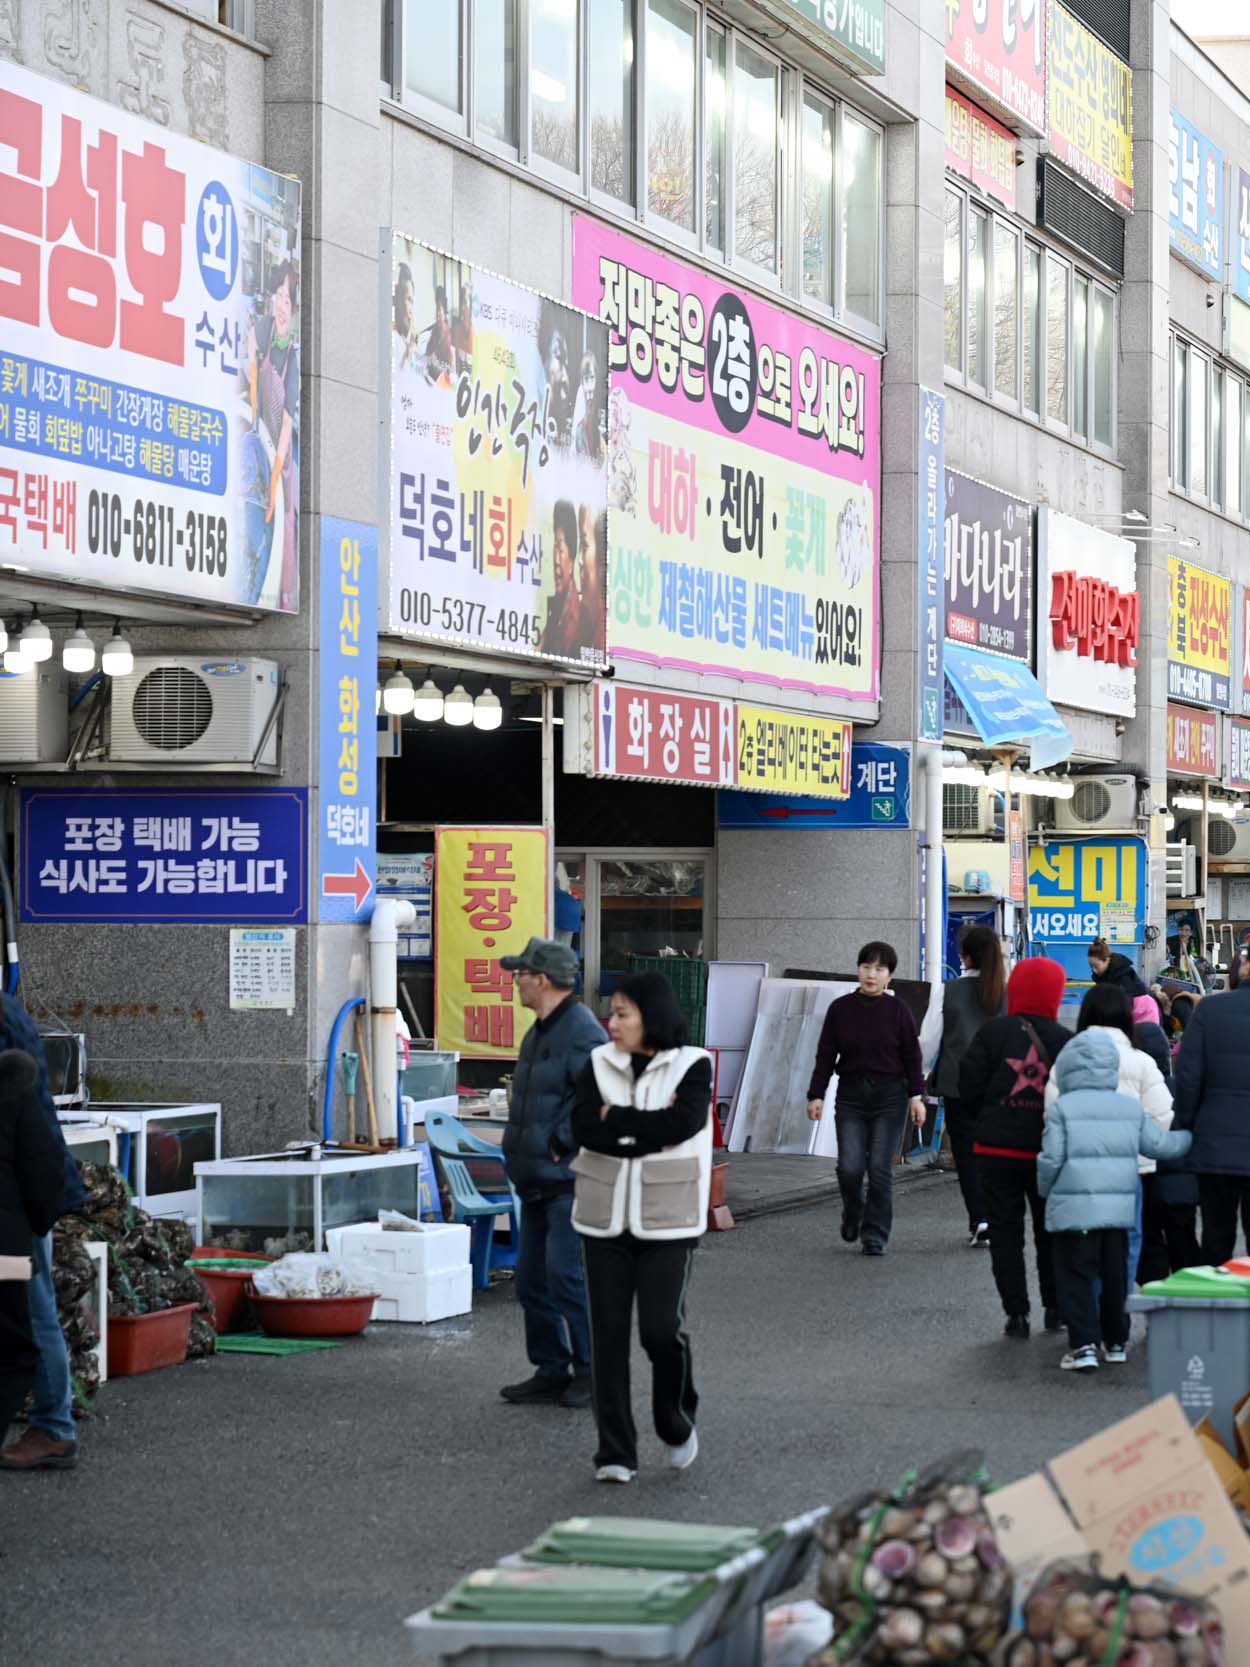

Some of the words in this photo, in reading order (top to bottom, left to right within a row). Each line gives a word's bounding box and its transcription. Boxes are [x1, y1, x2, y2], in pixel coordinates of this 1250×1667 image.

[201, 193, 232, 285] 회
[195, 311, 241, 377] 수산
[599, 256, 705, 402] 전망좋은
[797, 347, 865, 459] 오세요!
[1, 357, 28, 398] 꽃게
[32, 370, 70, 408] 새조개
[116, 389, 164, 433] 간장게장
[168, 402, 223, 448] 해물칼국수
[14, 407, 40, 445] 물회
[45, 415, 83, 456] 회덮밥
[87, 425, 135, 469] 아나고탕
[140, 439, 175, 478] 해물탕
[178, 449, 212, 487] 매운탕
[88, 489, 227, 577] 010-6811-3158
[648, 439, 698, 541] 대하
[720, 464, 764, 559] 전어
[339, 537, 361, 658] 안산
[400, 588, 541, 646] 010-5377-4845
[608, 545, 654, 629] 싱한
[658, 559, 748, 650] 제철해산물
[751, 582, 814, 662] 세트메뉴
[815, 597, 863, 668] 있어요!
[627, 697, 713, 775] 화장실
[756, 718, 808, 783] 엘리베이터
[857, 761, 898, 793] 계단
[64, 817, 124, 853] 포장
[132, 817, 192, 852] 택배
[201, 817, 260, 852] 가능
[327, 804, 370, 847] 덕호네
[39, 858, 127, 894] 식사도
[137, 858, 287, 894] 가능합니다
